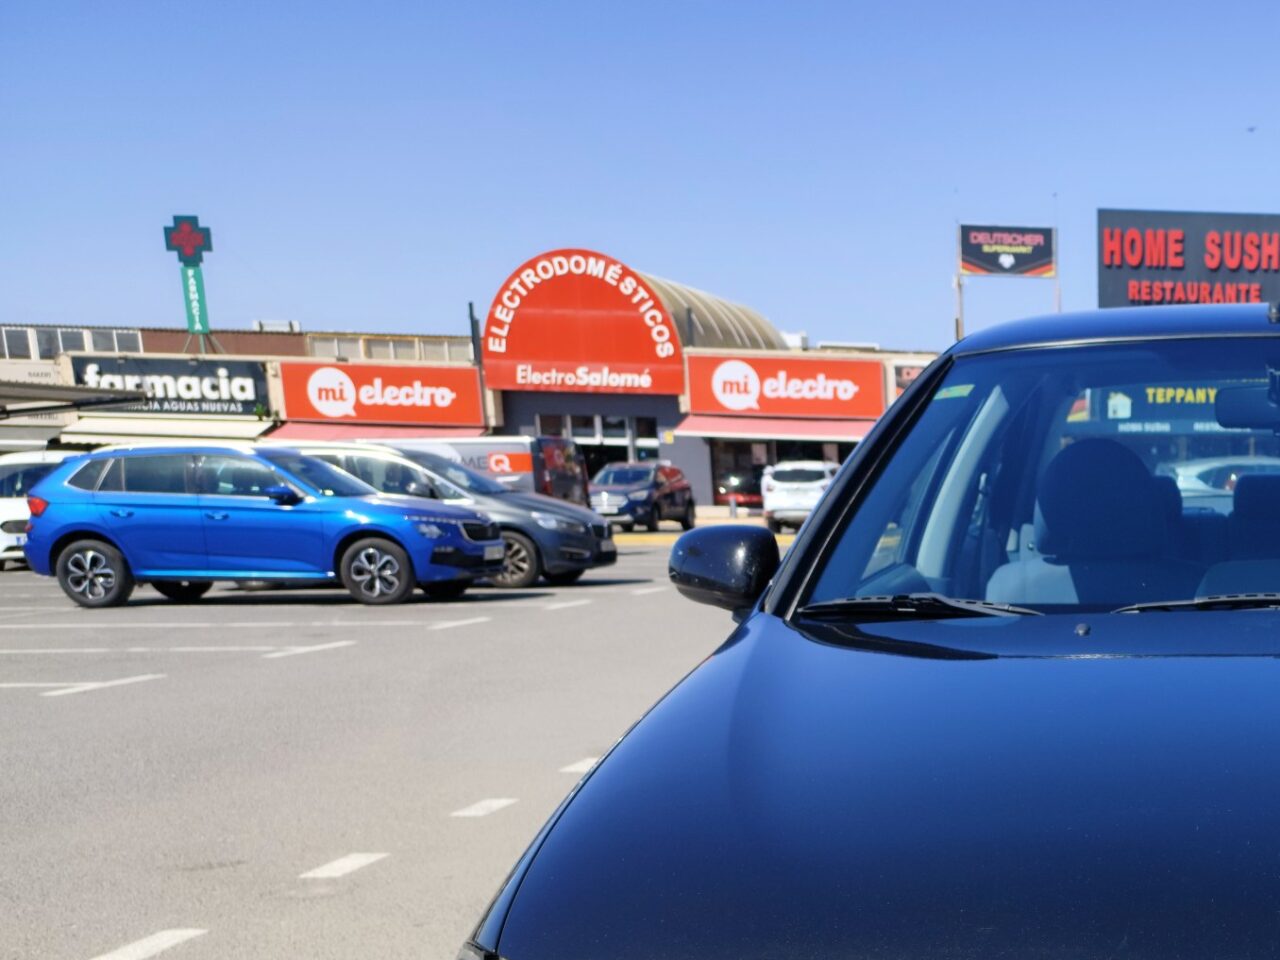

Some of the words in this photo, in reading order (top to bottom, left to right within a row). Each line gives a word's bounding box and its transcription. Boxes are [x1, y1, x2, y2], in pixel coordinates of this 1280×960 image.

[1103, 227, 1186, 269] HOME
[488, 255, 675, 358] ELECTRODOMÉSTICOS
[1127, 280, 1262, 304] RESTAURANTE
[83, 363, 256, 400] farmacia
[516, 364, 652, 388] ElectroSalomé
[722, 375, 750, 395] mi
[762, 370, 859, 401] electro
[163, 401, 199, 413] AGUAS
[201, 402, 243, 413] NUEVAS
[317, 382, 347, 401] mi
[358, 377, 456, 407] electro
[1146, 387, 1217, 404] TEPPANY
